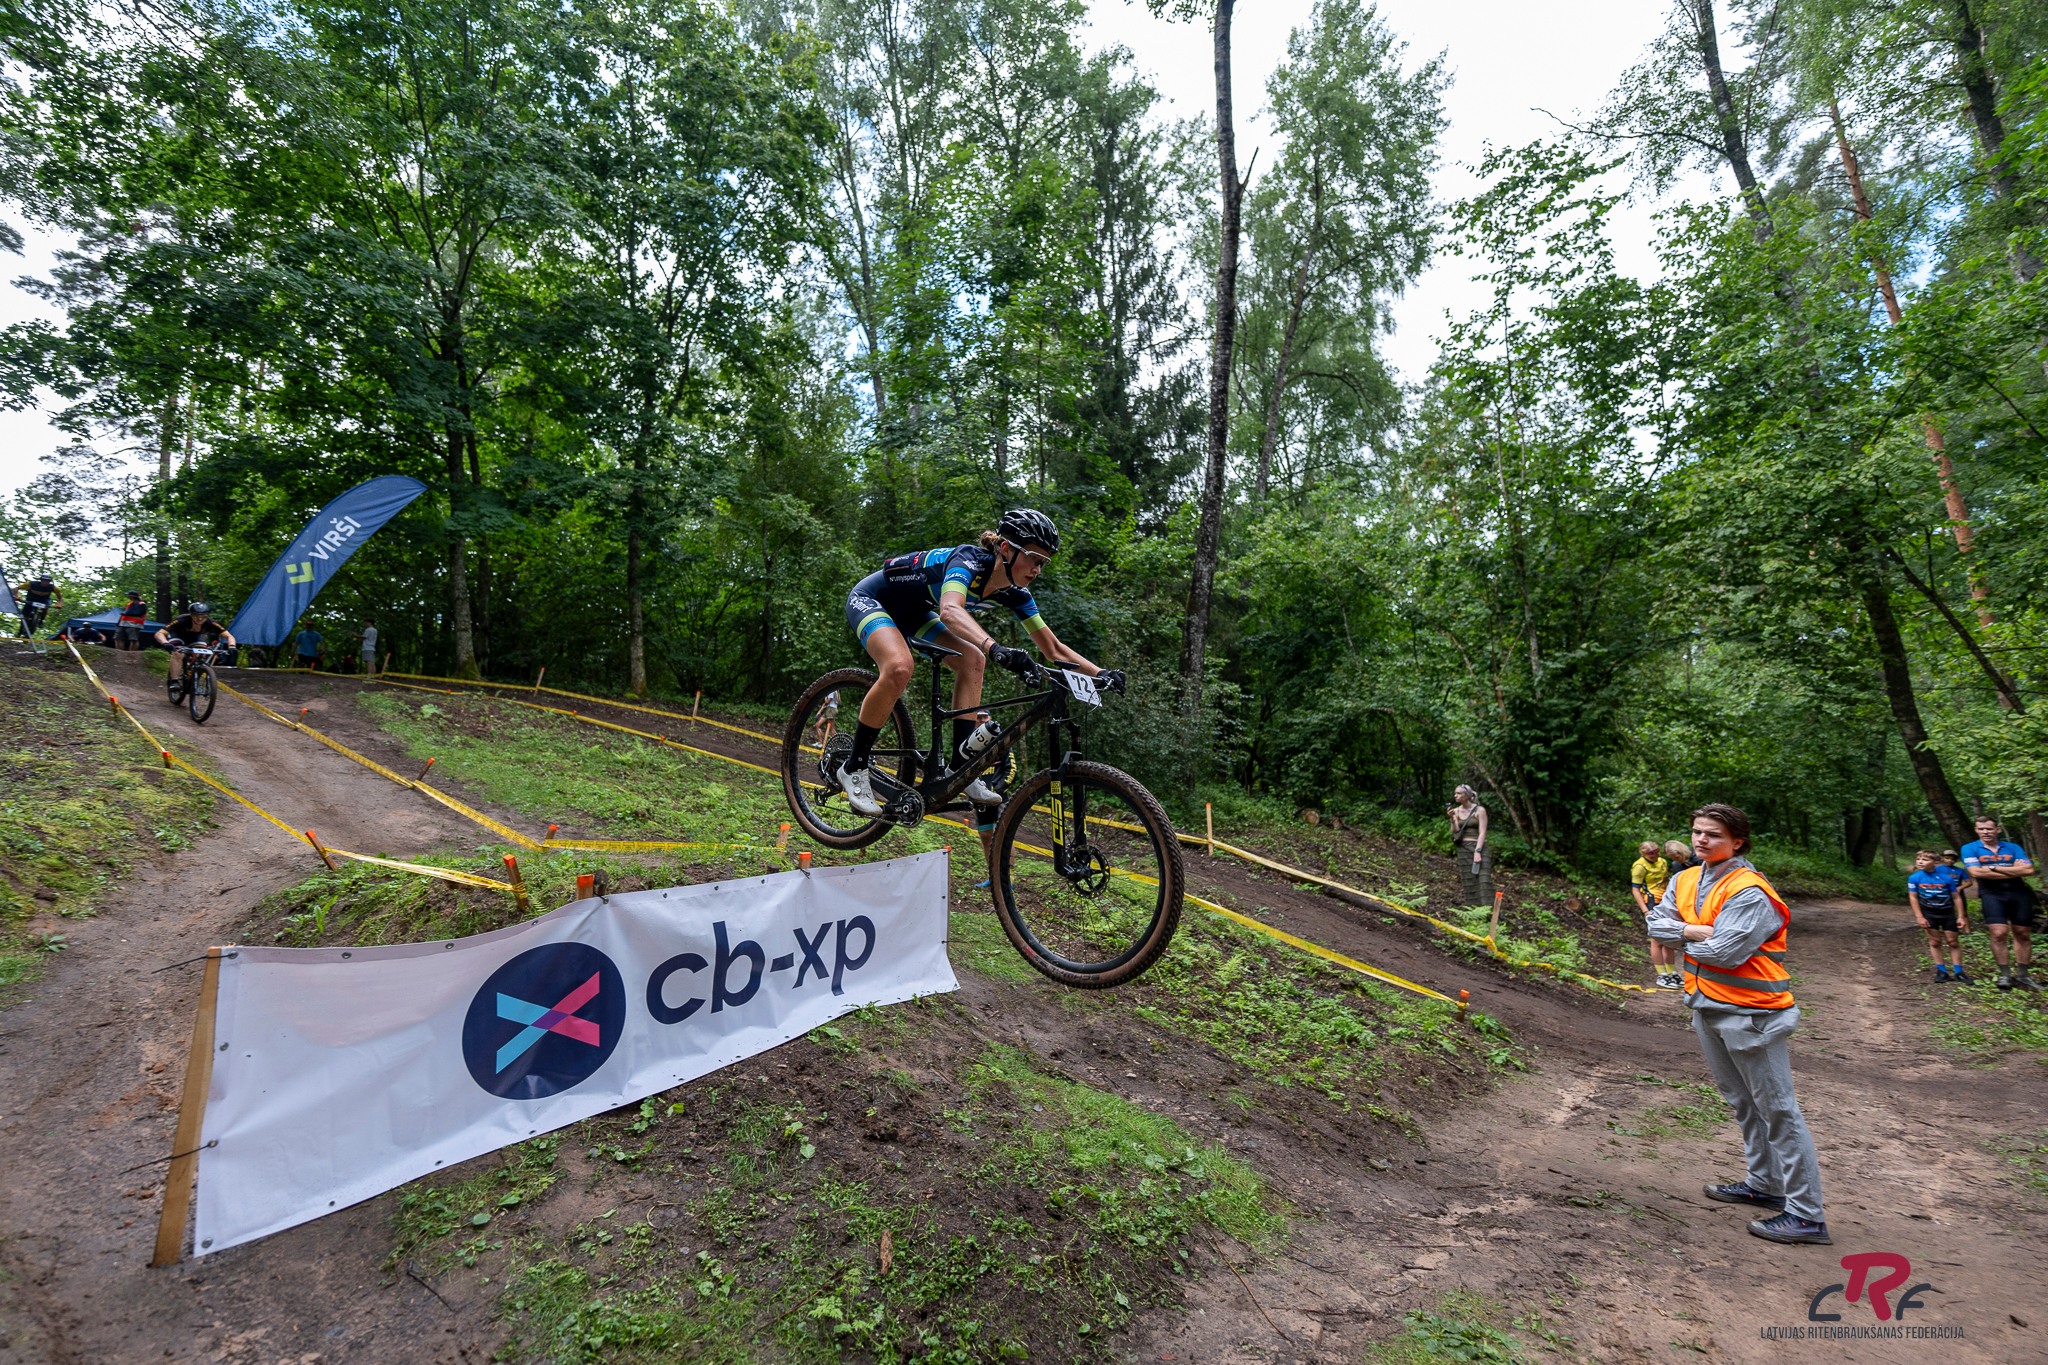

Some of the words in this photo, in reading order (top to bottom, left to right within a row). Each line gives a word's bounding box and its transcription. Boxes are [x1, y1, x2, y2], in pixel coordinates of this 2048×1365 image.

[308, 515, 361, 560] VIRŠI
[1071, 674, 1092, 694] 72
[645, 914, 876, 1025] cb-xp
